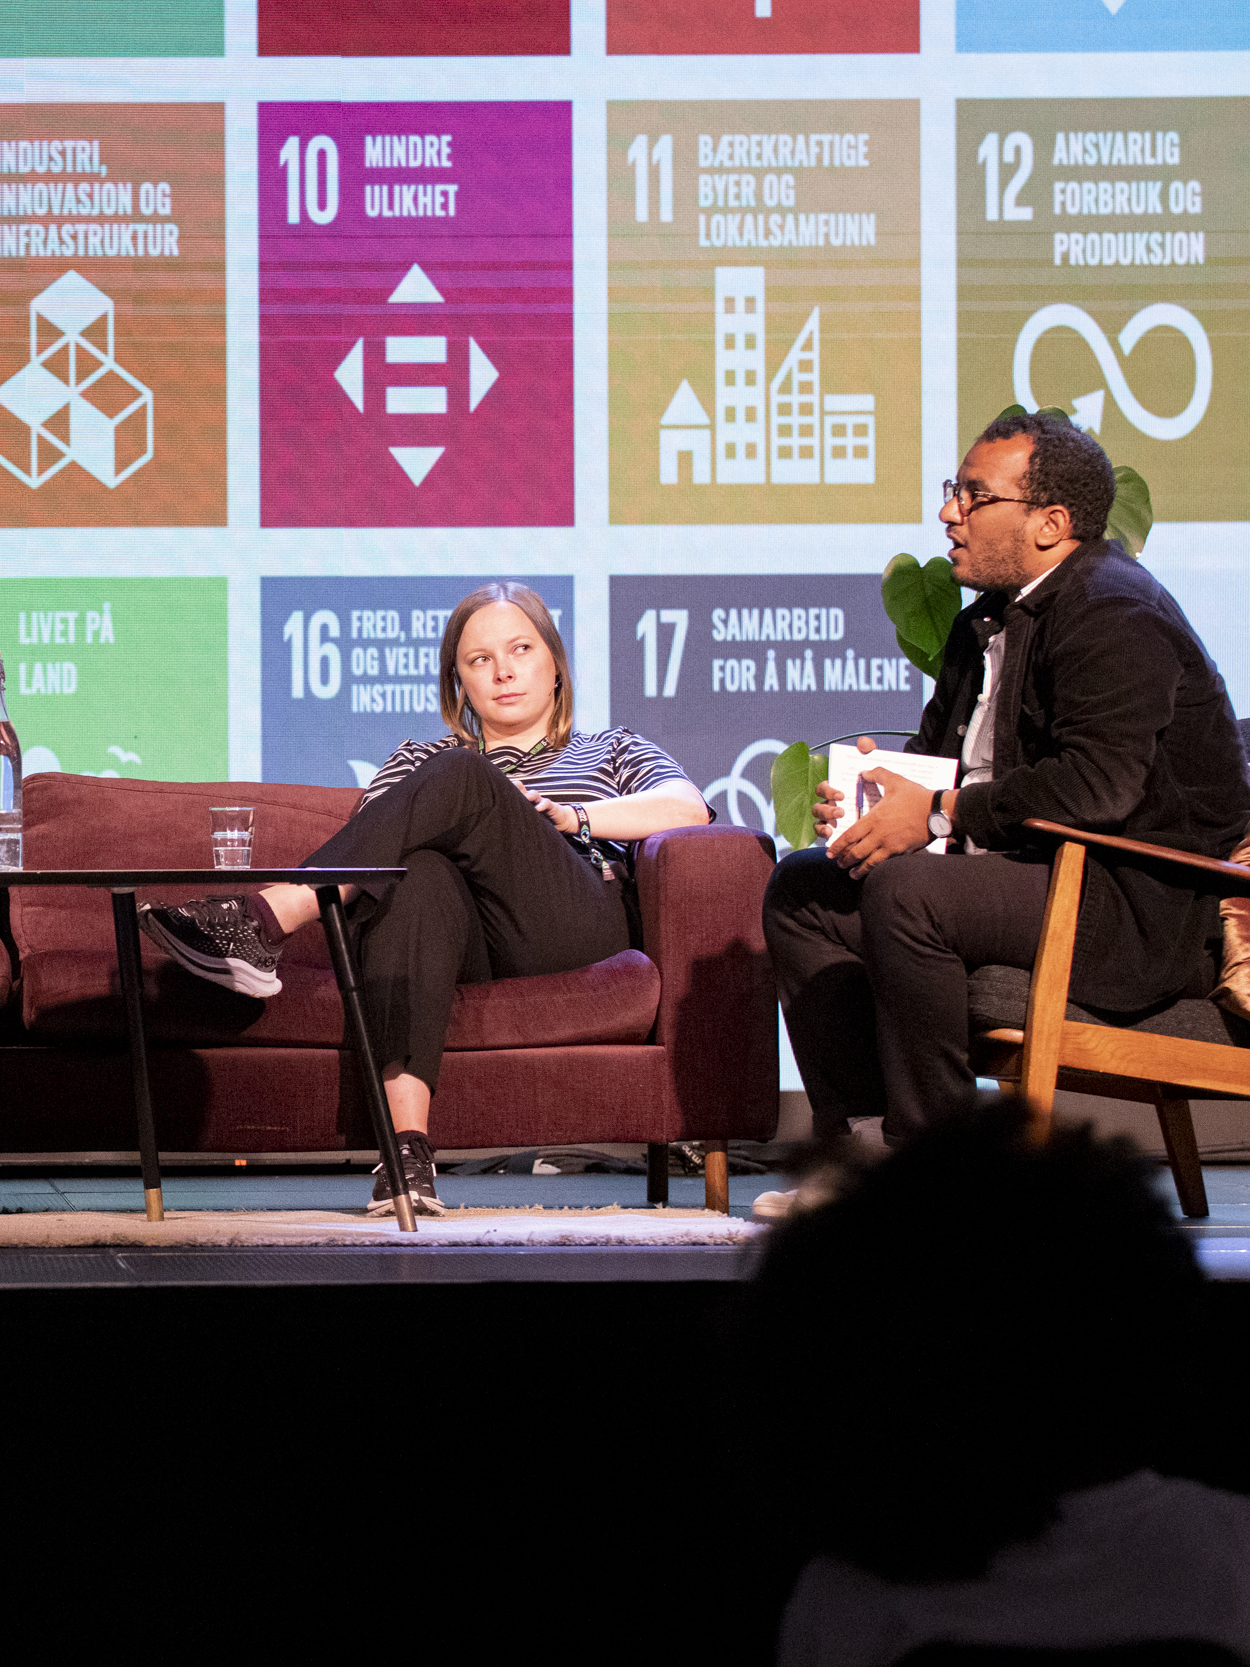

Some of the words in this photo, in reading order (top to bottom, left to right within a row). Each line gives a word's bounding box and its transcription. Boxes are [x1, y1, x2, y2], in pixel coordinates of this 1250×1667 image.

[364, 135, 452, 167] MINDRE
[698, 133, 870, 168] BÆREKRAFTIGE
[1052, 131, 1180, 166] ANSVARLIG
[279, 135, 339, 225] 10
[627, 134, 673, 223] 11
[698, 174, 756, 207] BYER
[763, 173, 795, 207] OG
[978, 131, 1034, 221] 12
[139, 182, 171, 216] OG
[364, 184, 458, 217] ULIKHET
[1053, 181, 1163, 215] FORBRUK
[1169, 180, 1202, 215] OG
[698, 213, 876, 247] LOKALSAMFUNN
[1053, 231, 1205, 266] PRODUKSJON
[19, 611, 79, 644] LIVET
[87, 602, 115, 644] PÅ
[352, 609, 406, 642] FRED,
[712, 607, 844, 641] SAMARBEID
[284, 610, 341, 699] 16
[352, 647, 379, 675] OG
[637, 609, 689, 697] 17
[712, 659, 756, 691] FOR
[764, 649, 779, 691] Å
[786, 649, 817, 691] NÅ
[824, 649, 910, 691] MÅLENE
[19, 662, 77, 695] LAND
[352, 683, 438, 713] INSTITUS
